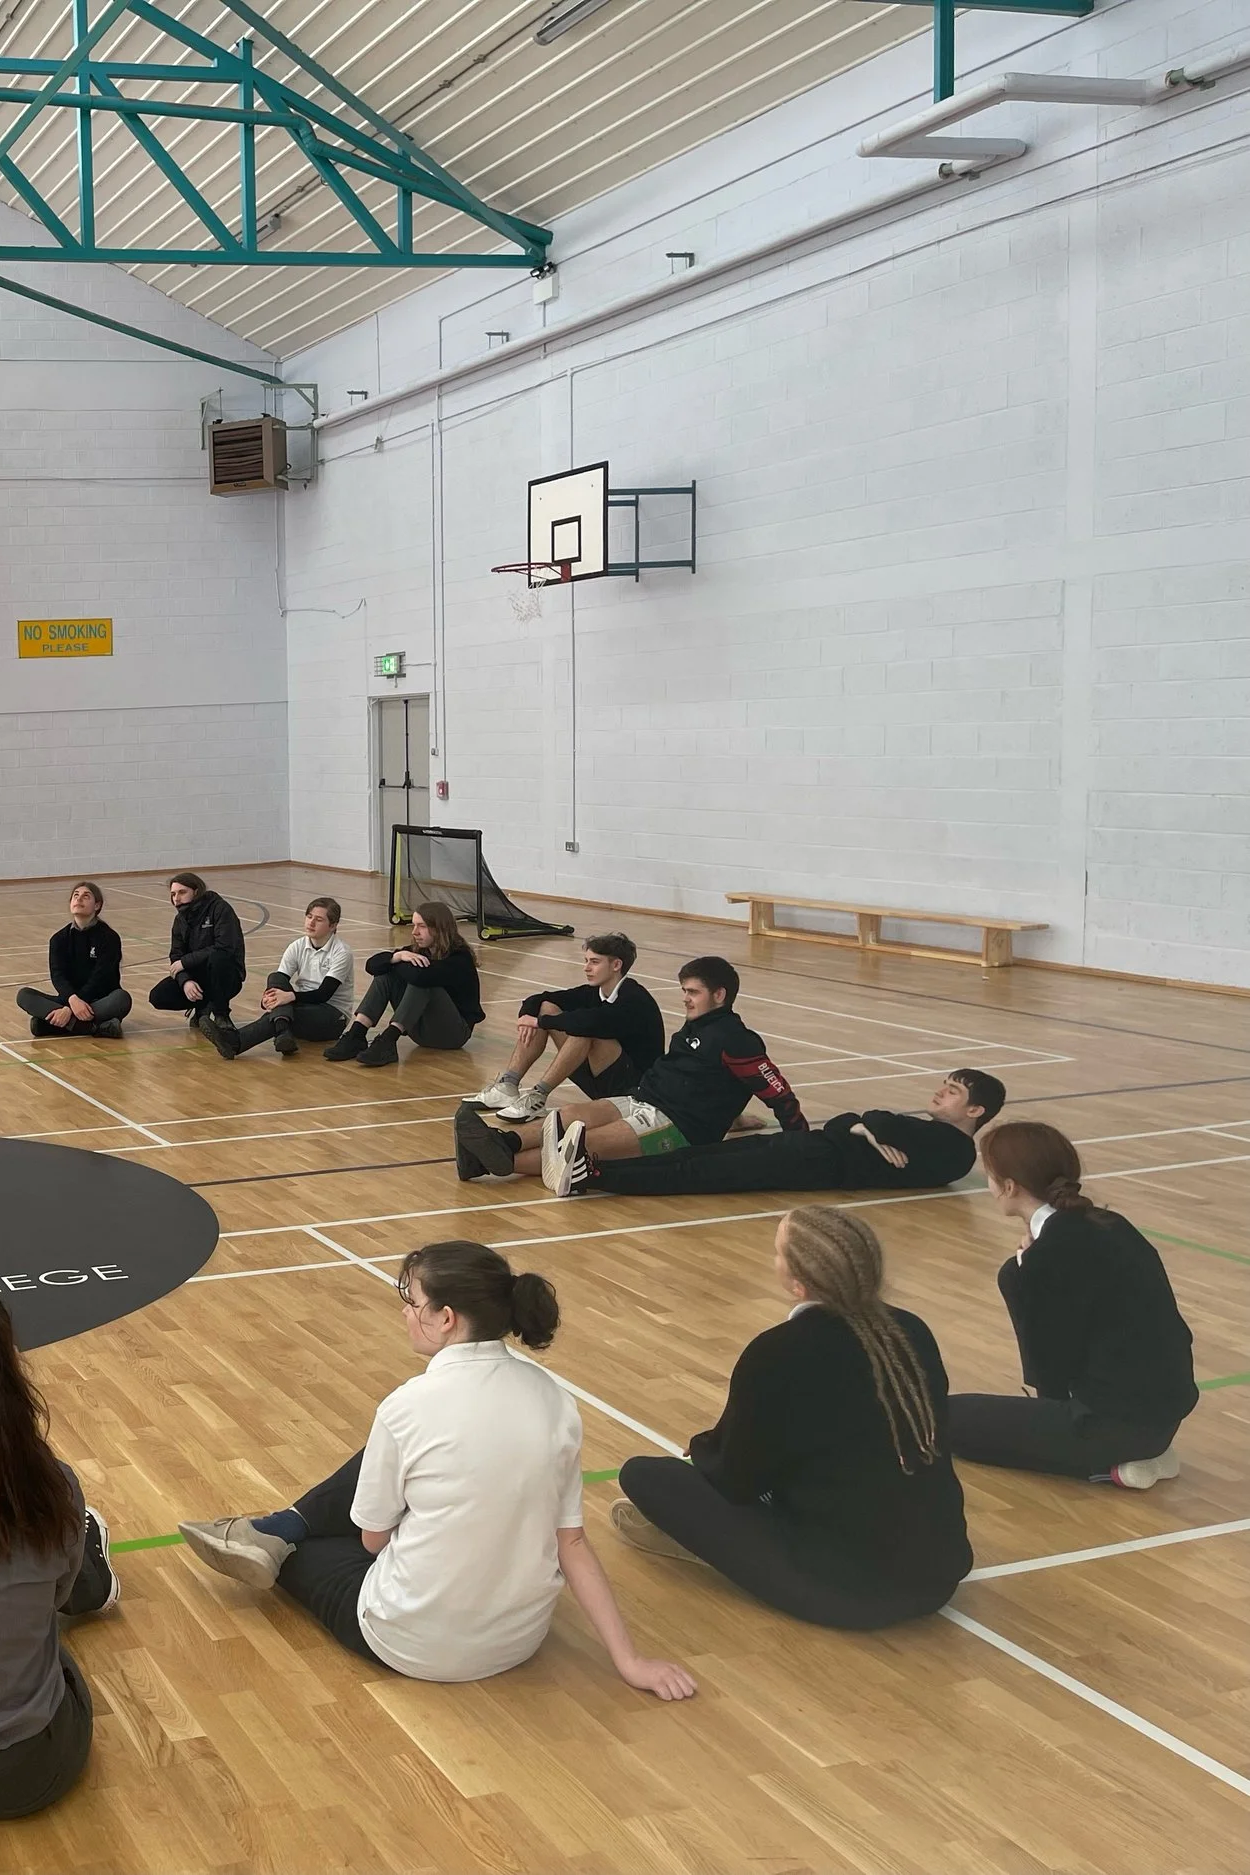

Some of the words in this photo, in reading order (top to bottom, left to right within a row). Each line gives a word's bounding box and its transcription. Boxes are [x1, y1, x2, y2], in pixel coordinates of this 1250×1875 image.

[24, 625, 42, 640] NO
[48, 623, 107, 640] SMOKING
[42, 643, 89, 653] PLEASE
